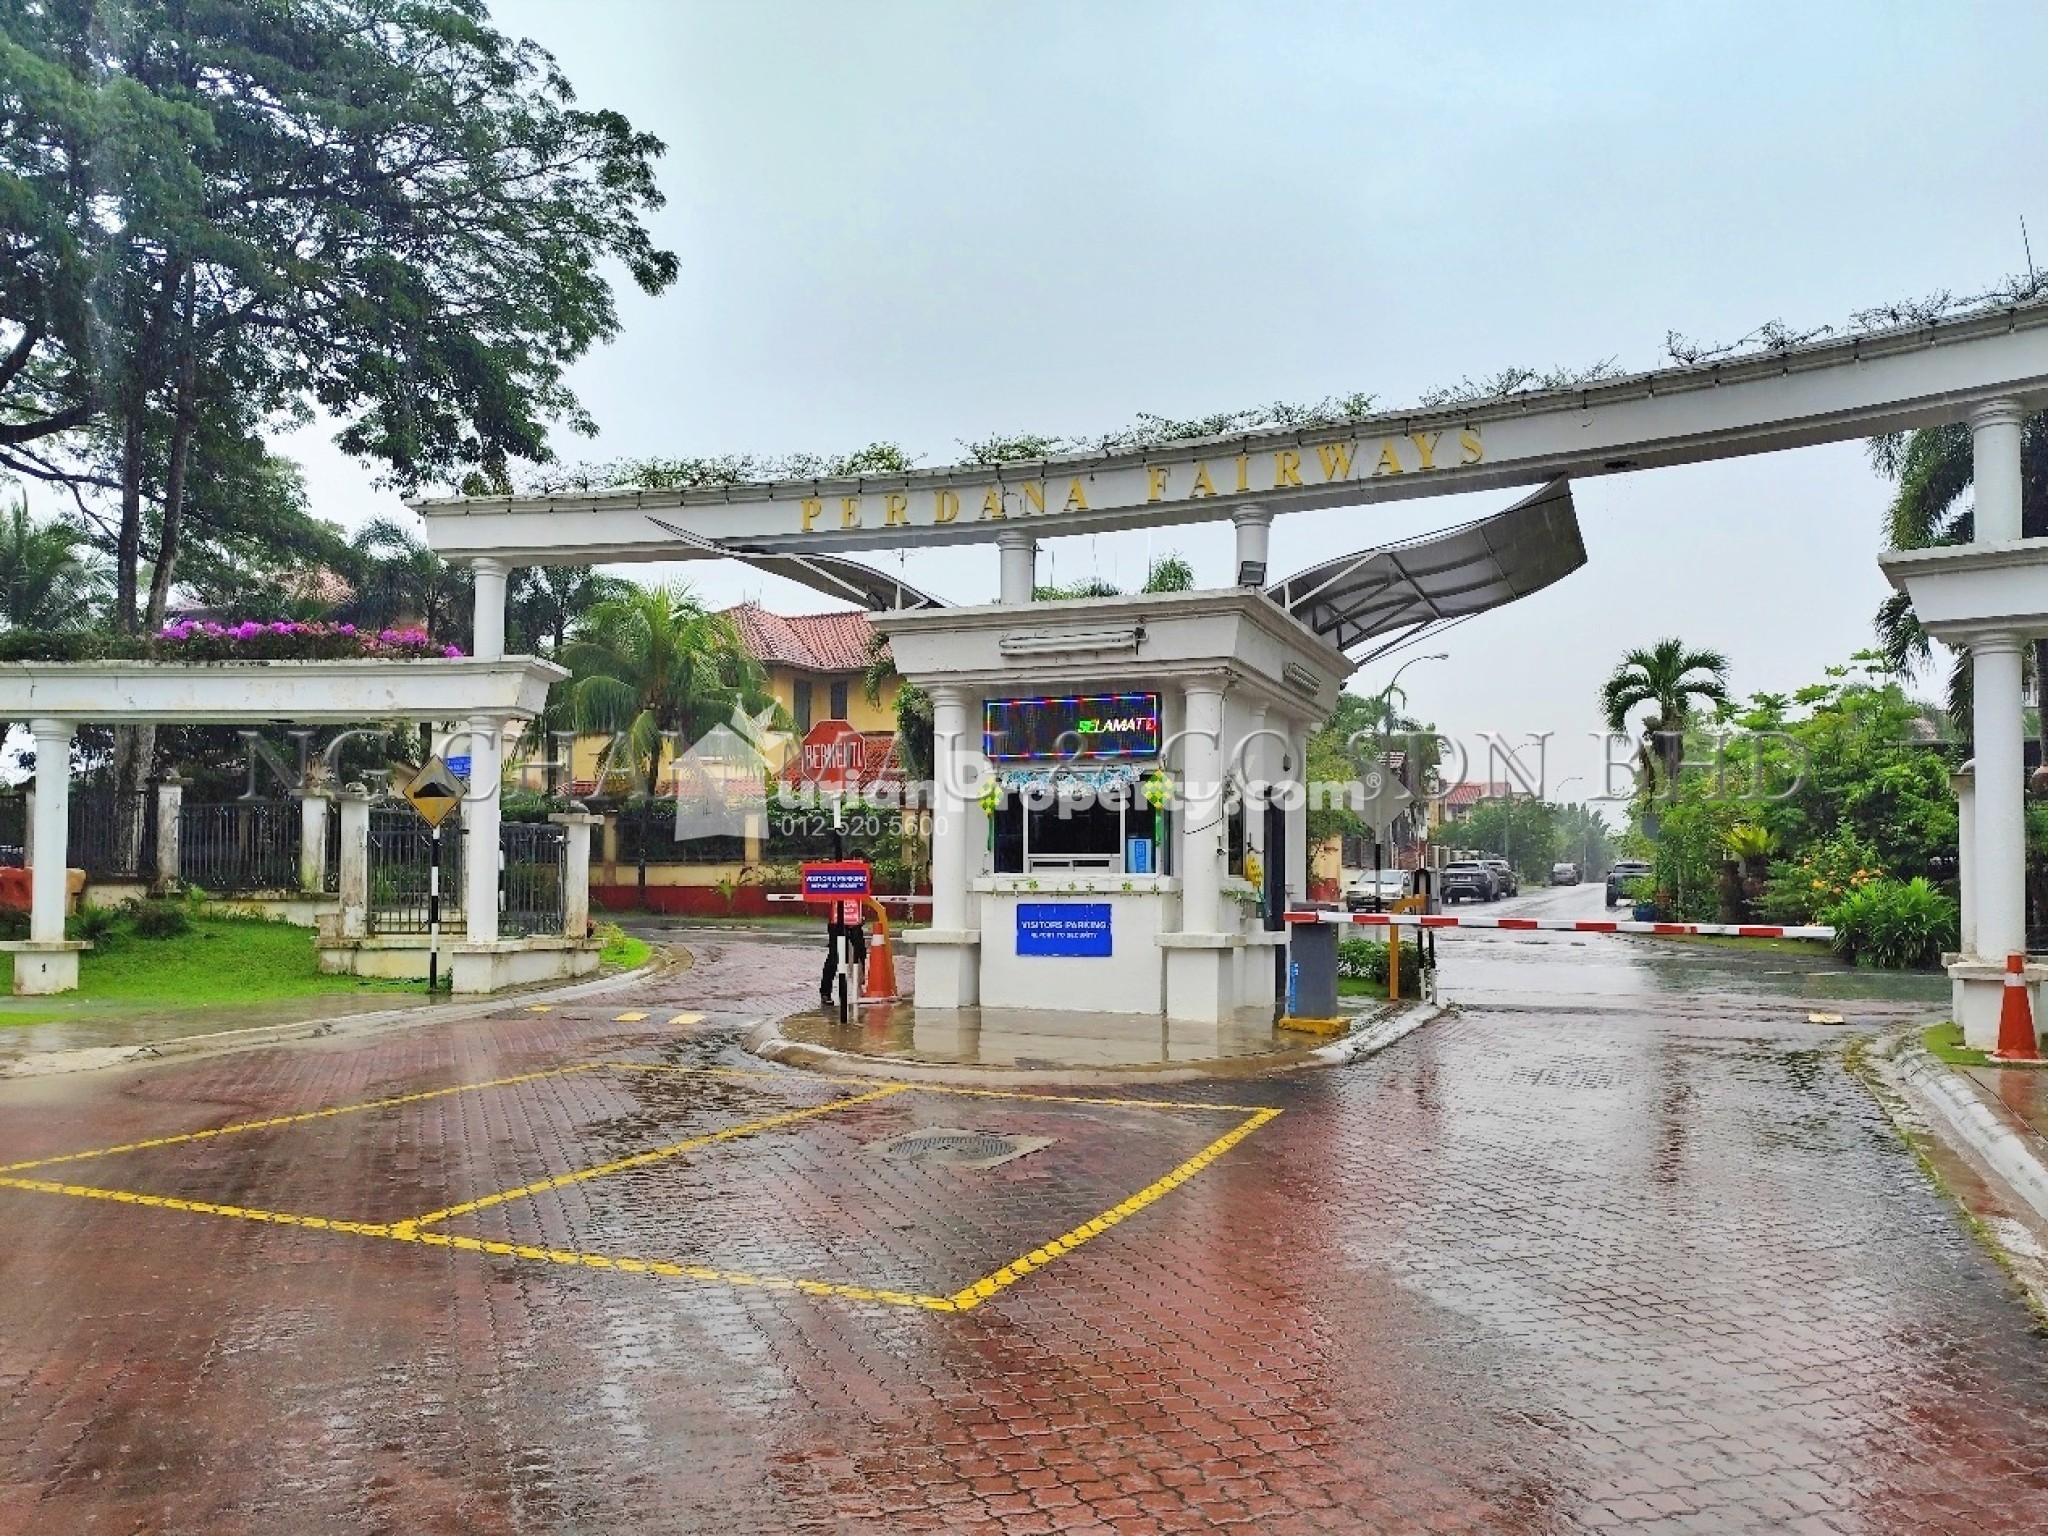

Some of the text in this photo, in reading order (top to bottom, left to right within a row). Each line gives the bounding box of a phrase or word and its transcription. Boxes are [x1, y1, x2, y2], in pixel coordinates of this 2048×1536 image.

[801, 427, 1484, 532] PERDANA FAIRWAYS
[1078, 717, 1146, 733] SELAMAT
[1021, 920, 1107, 929] VISITORS PARKING
